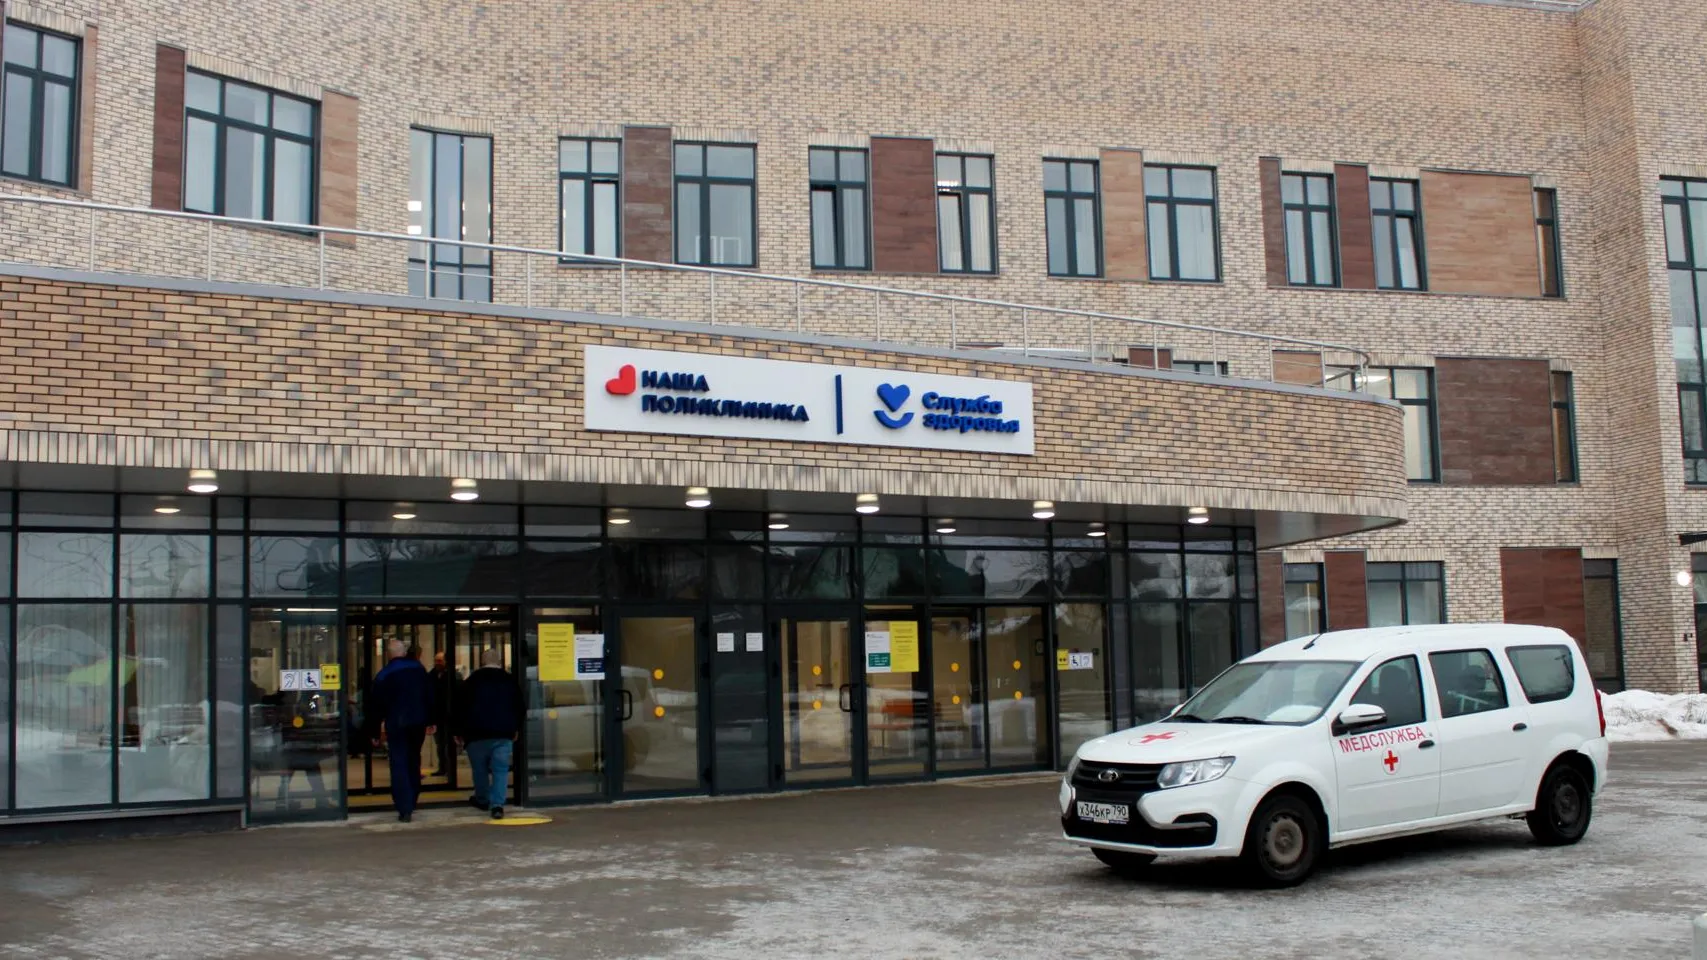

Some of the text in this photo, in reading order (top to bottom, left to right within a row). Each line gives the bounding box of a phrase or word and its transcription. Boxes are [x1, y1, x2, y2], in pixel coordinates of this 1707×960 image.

[641, 369, 710, 392] НАША
[641, 394, 810, 422] ПОЛИКЛИНИКА
[921, 391, 1003, 415] Служба
[922, 412, 1020, 433] здоровья
[1339, 726, 1426, 753] МЕДСЛУЖБА
[1112, 805, 1126, 816] 790
